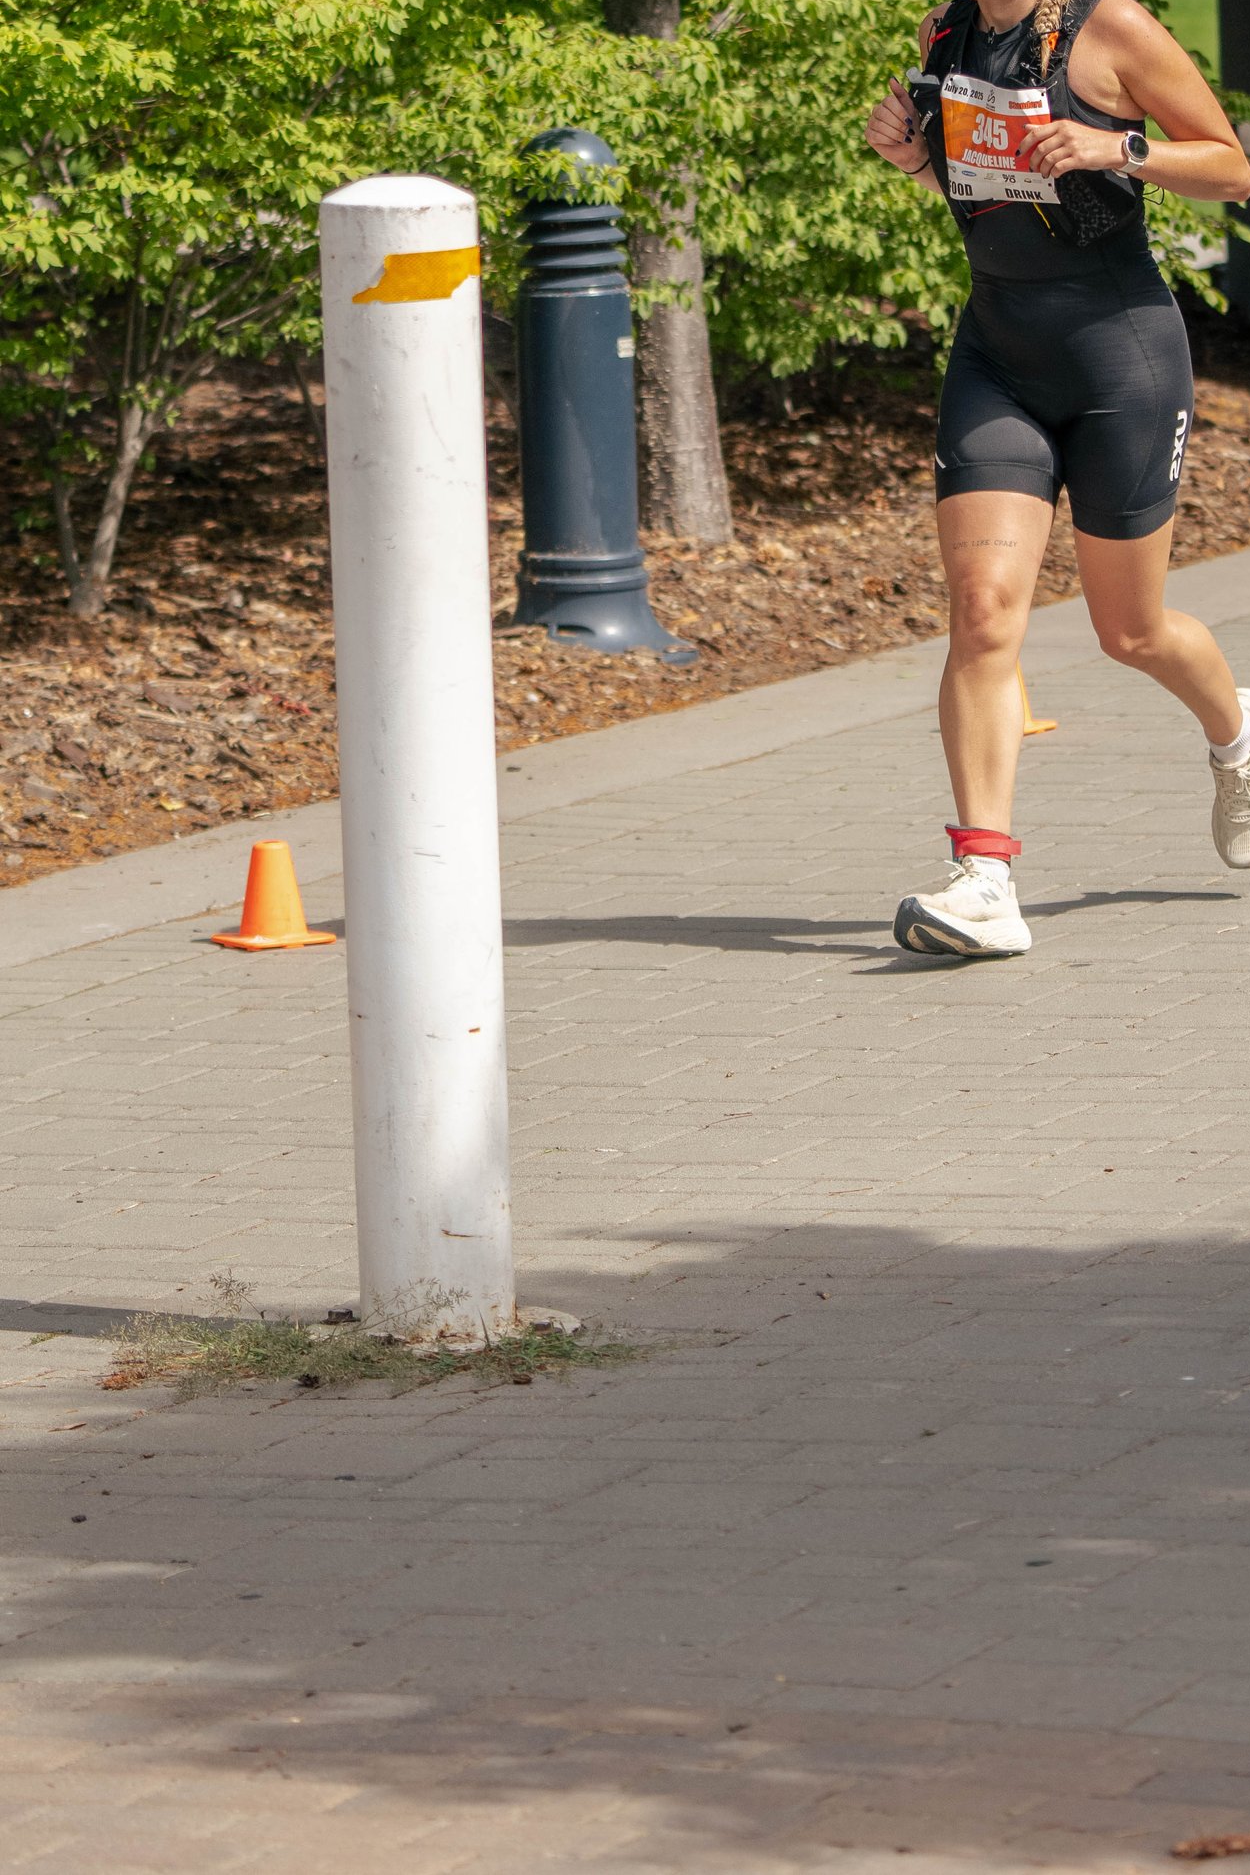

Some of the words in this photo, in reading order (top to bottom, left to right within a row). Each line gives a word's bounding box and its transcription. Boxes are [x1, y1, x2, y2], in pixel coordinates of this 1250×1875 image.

[944, 83, 959, 94] July
[970, 90, 984, 101] 2025
[972, 113, 1009, 151] 345
[961, 148, 1017, 170] JACQUELINE
[1005, 187, 1044, 201] DRINK
[1169, 410, 1188, 482] 2XU
